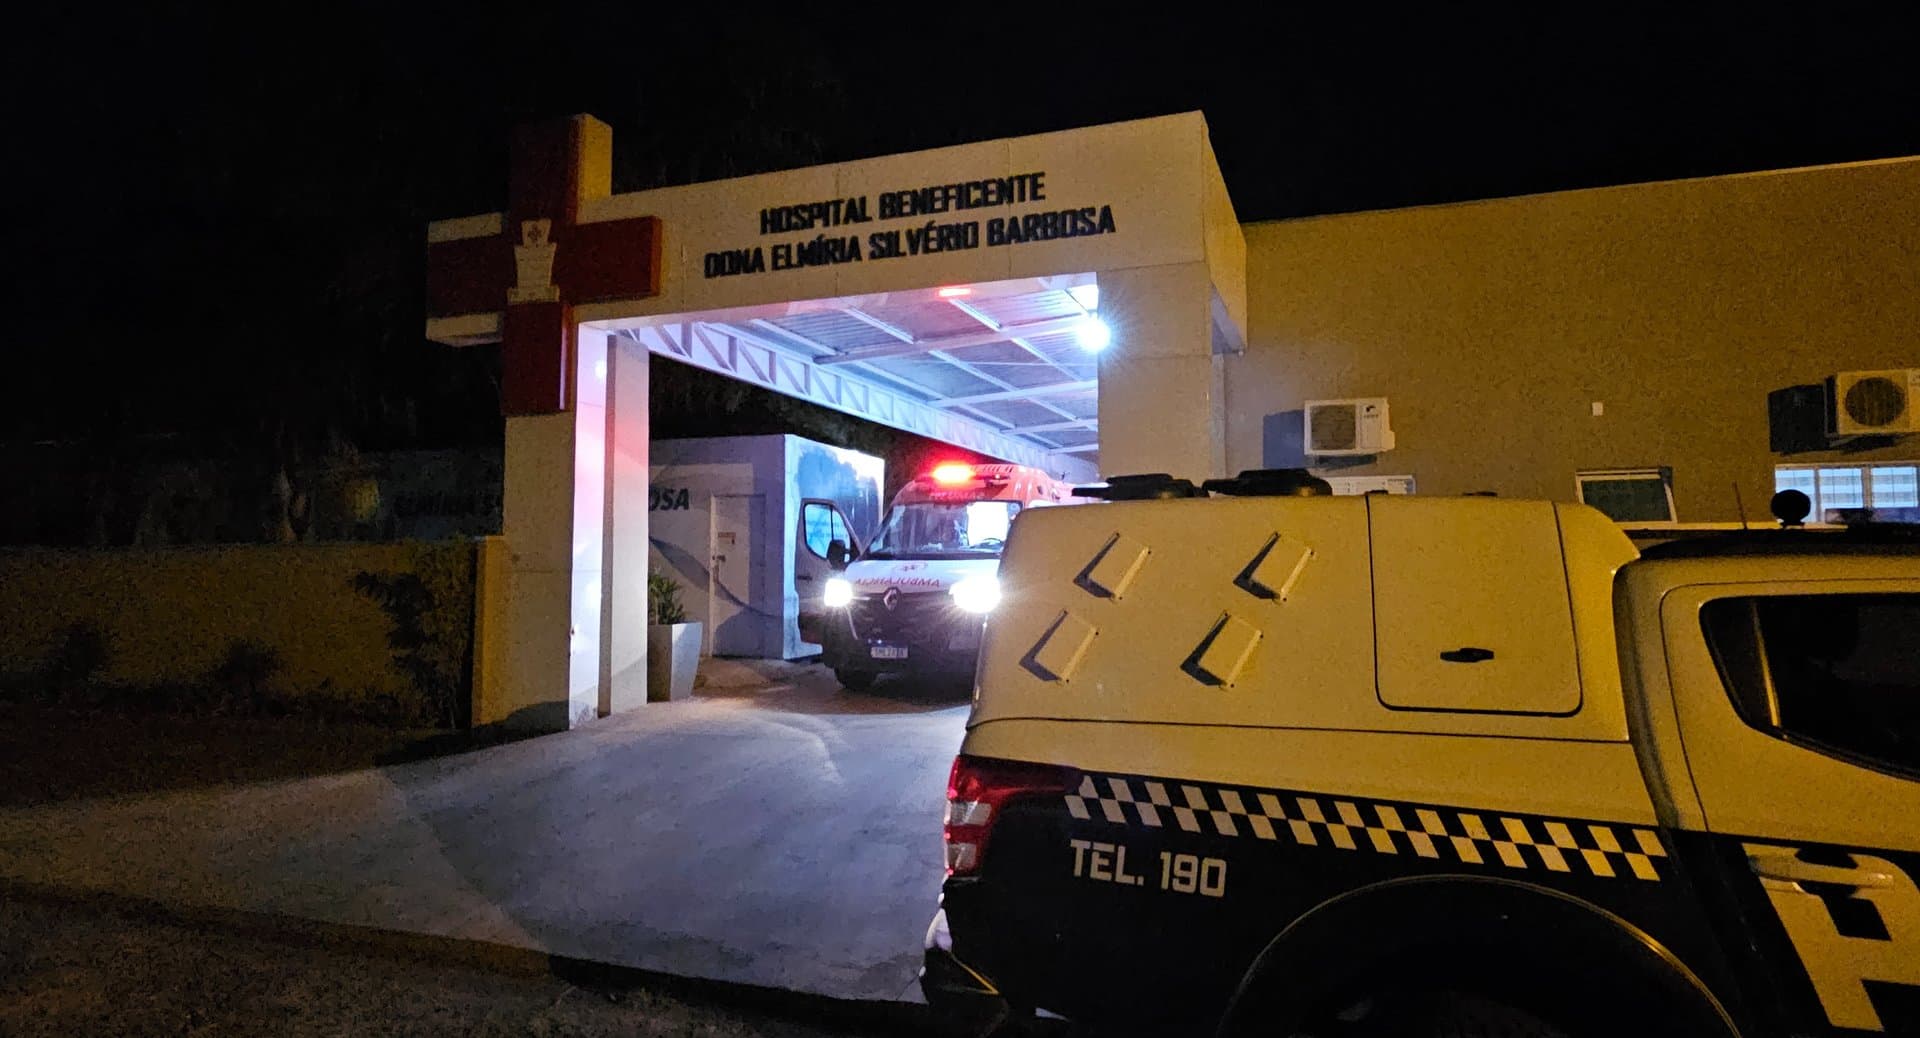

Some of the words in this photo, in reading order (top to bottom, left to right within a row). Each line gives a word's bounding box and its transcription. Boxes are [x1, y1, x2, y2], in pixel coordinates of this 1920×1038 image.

[760, 196, 872, 235] HOSPITAL
[879, 172, 1046, 220] BENEFICENTE
[704, 247, 765, 279] DONA
[771, 233, 863, 271] ELMÍRIA
[868, 220, 979, 260] SILVÉRIO
[987, 205, 1116, 247] BARBOSA
[1070, 838, 1145, 887] TEL.
[1159, 850, 1228, 898] 190
